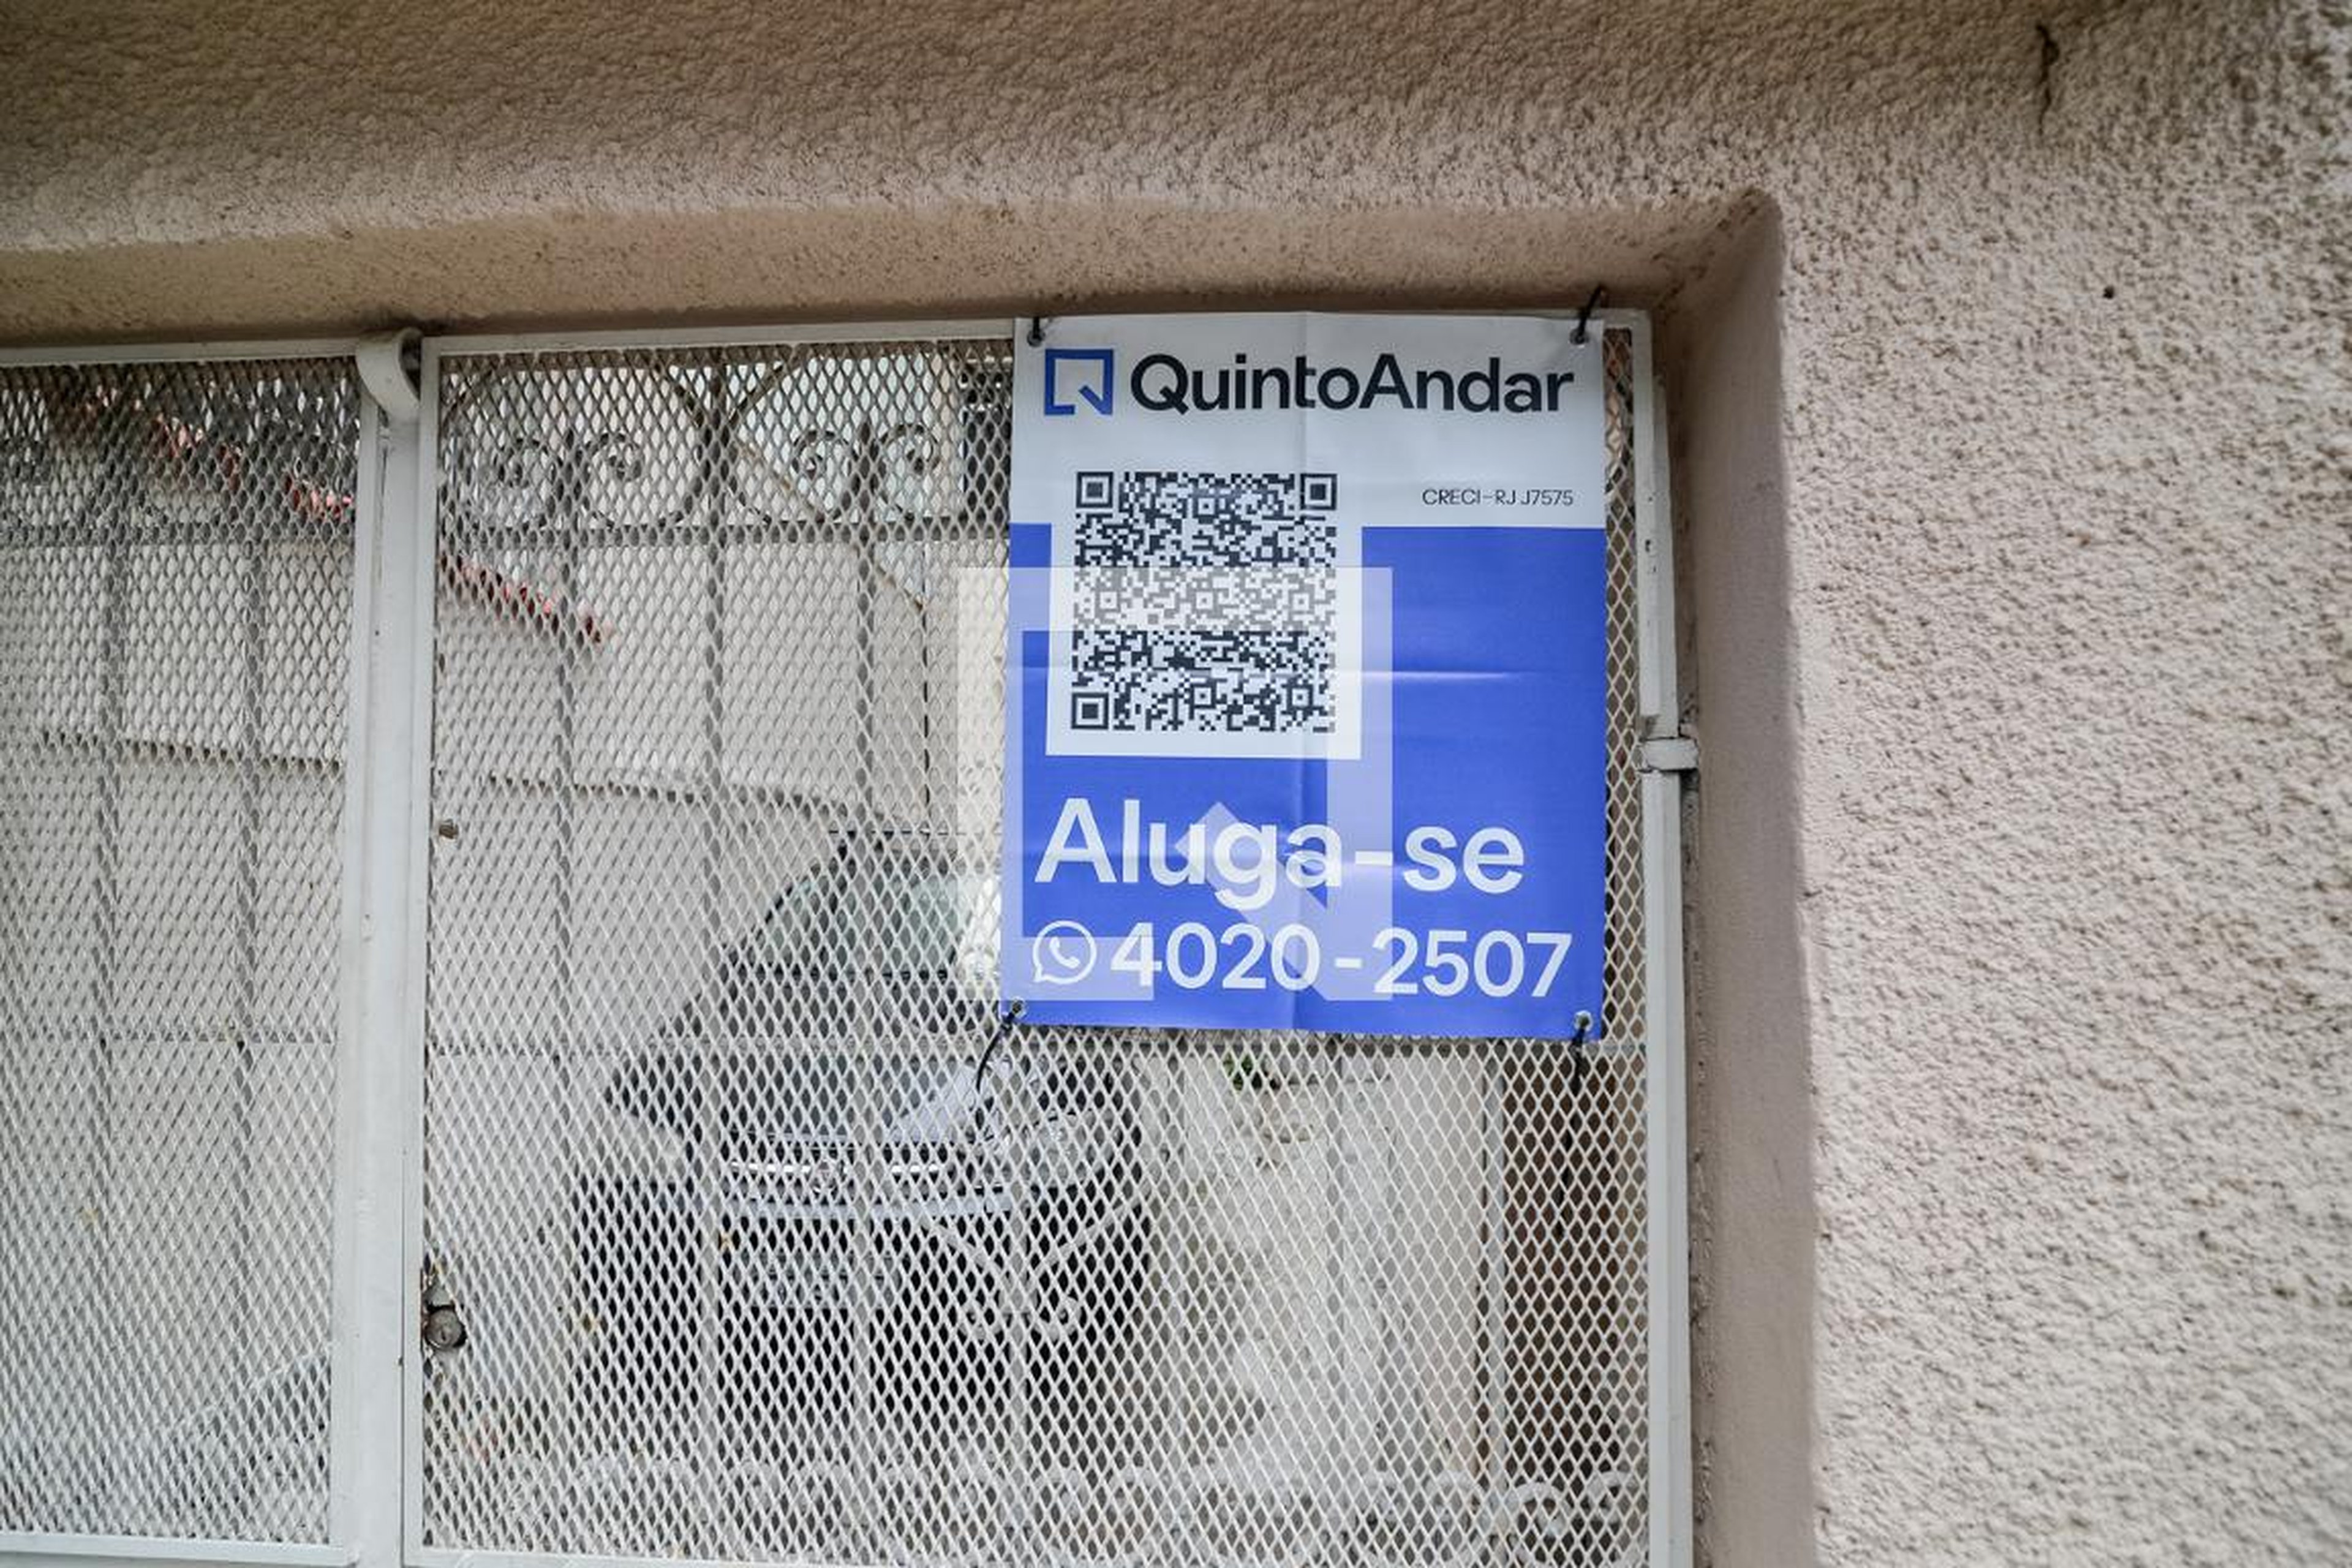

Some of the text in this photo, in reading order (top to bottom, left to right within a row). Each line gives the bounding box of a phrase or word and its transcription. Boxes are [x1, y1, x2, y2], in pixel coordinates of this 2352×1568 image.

[1131, 353, 1574, 415] QuintoAndar
[1422, 489, 1574, 505] CRECI-RJ J7575
[1035, 797, 1523, 910] Aluga-se
